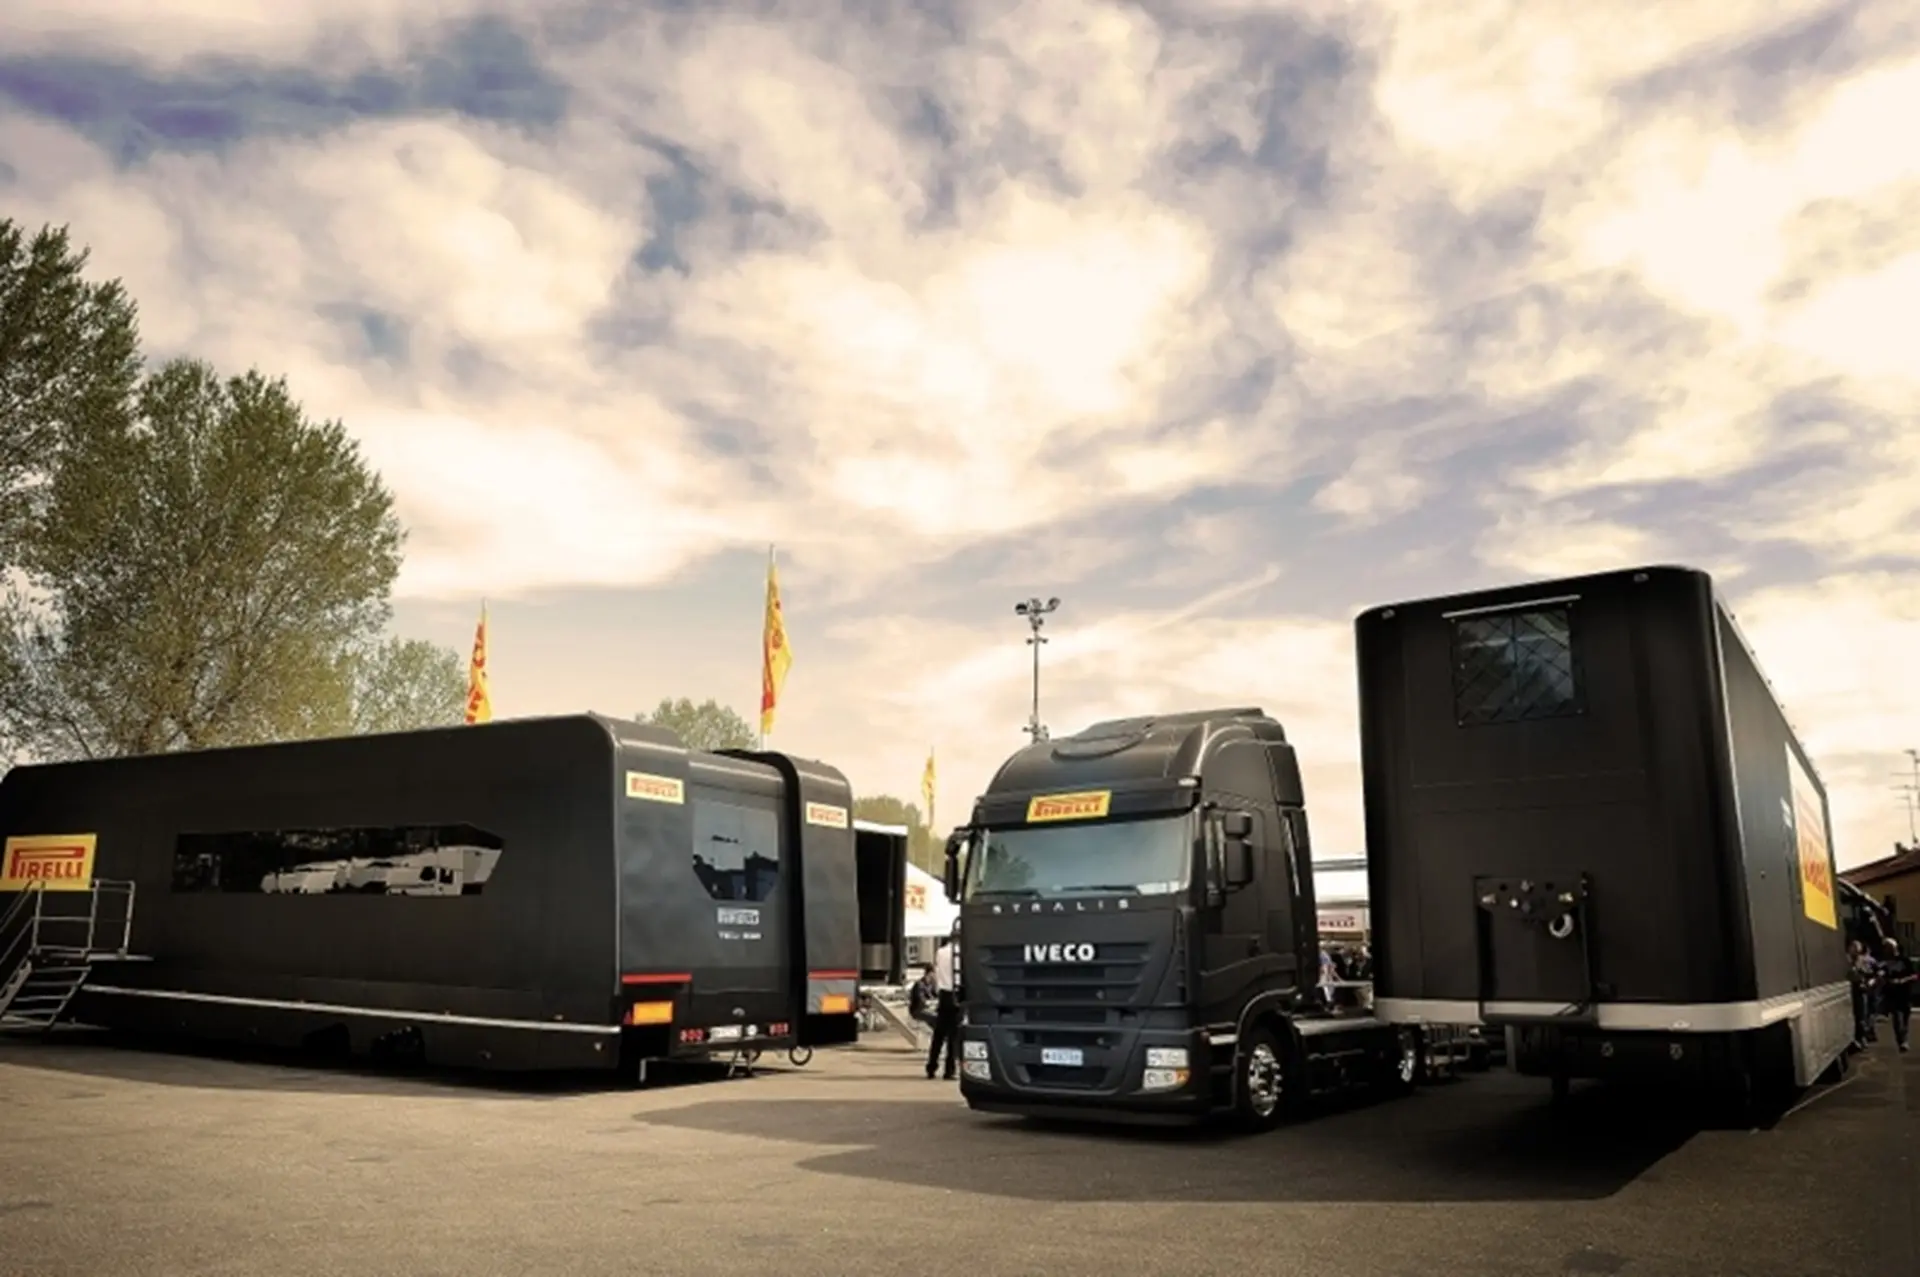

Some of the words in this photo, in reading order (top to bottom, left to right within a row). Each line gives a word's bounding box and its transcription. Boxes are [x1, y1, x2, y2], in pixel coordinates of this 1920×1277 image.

[1034, 794, 1105, 817] PIRELLI
[10, 846, 85, 878] PIRELLI
[992, 899, 1129, 914] STRALIS
[1024, 943, 1095, 963] IVECO
